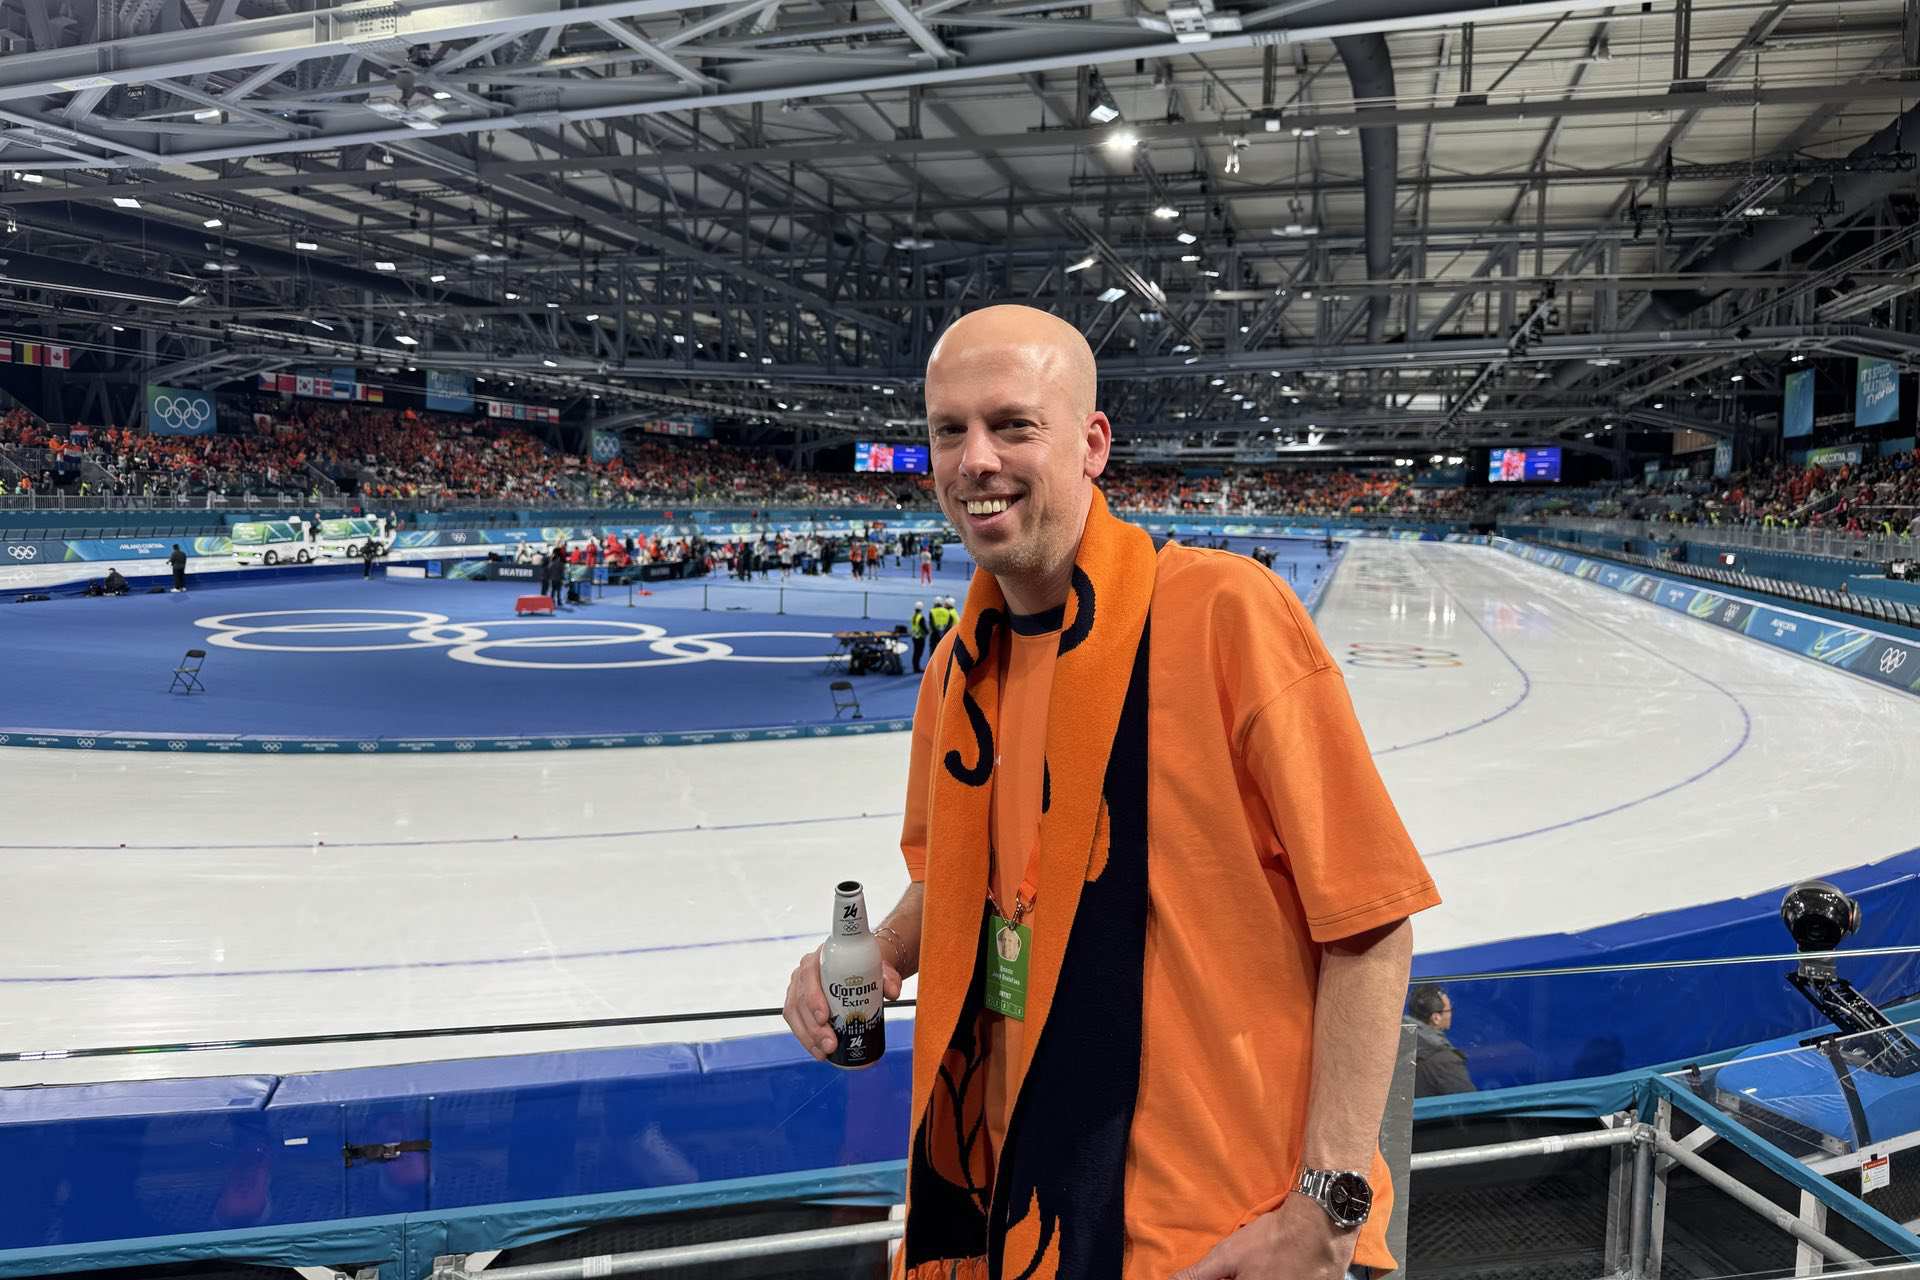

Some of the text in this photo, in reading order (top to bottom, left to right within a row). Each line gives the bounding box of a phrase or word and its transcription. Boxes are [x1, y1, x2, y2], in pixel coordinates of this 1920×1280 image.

[499, 568, 533, 577] SKATERS
[829, 981, 878, 1000] Corona
[842, 997, 870, 1007] Extra
